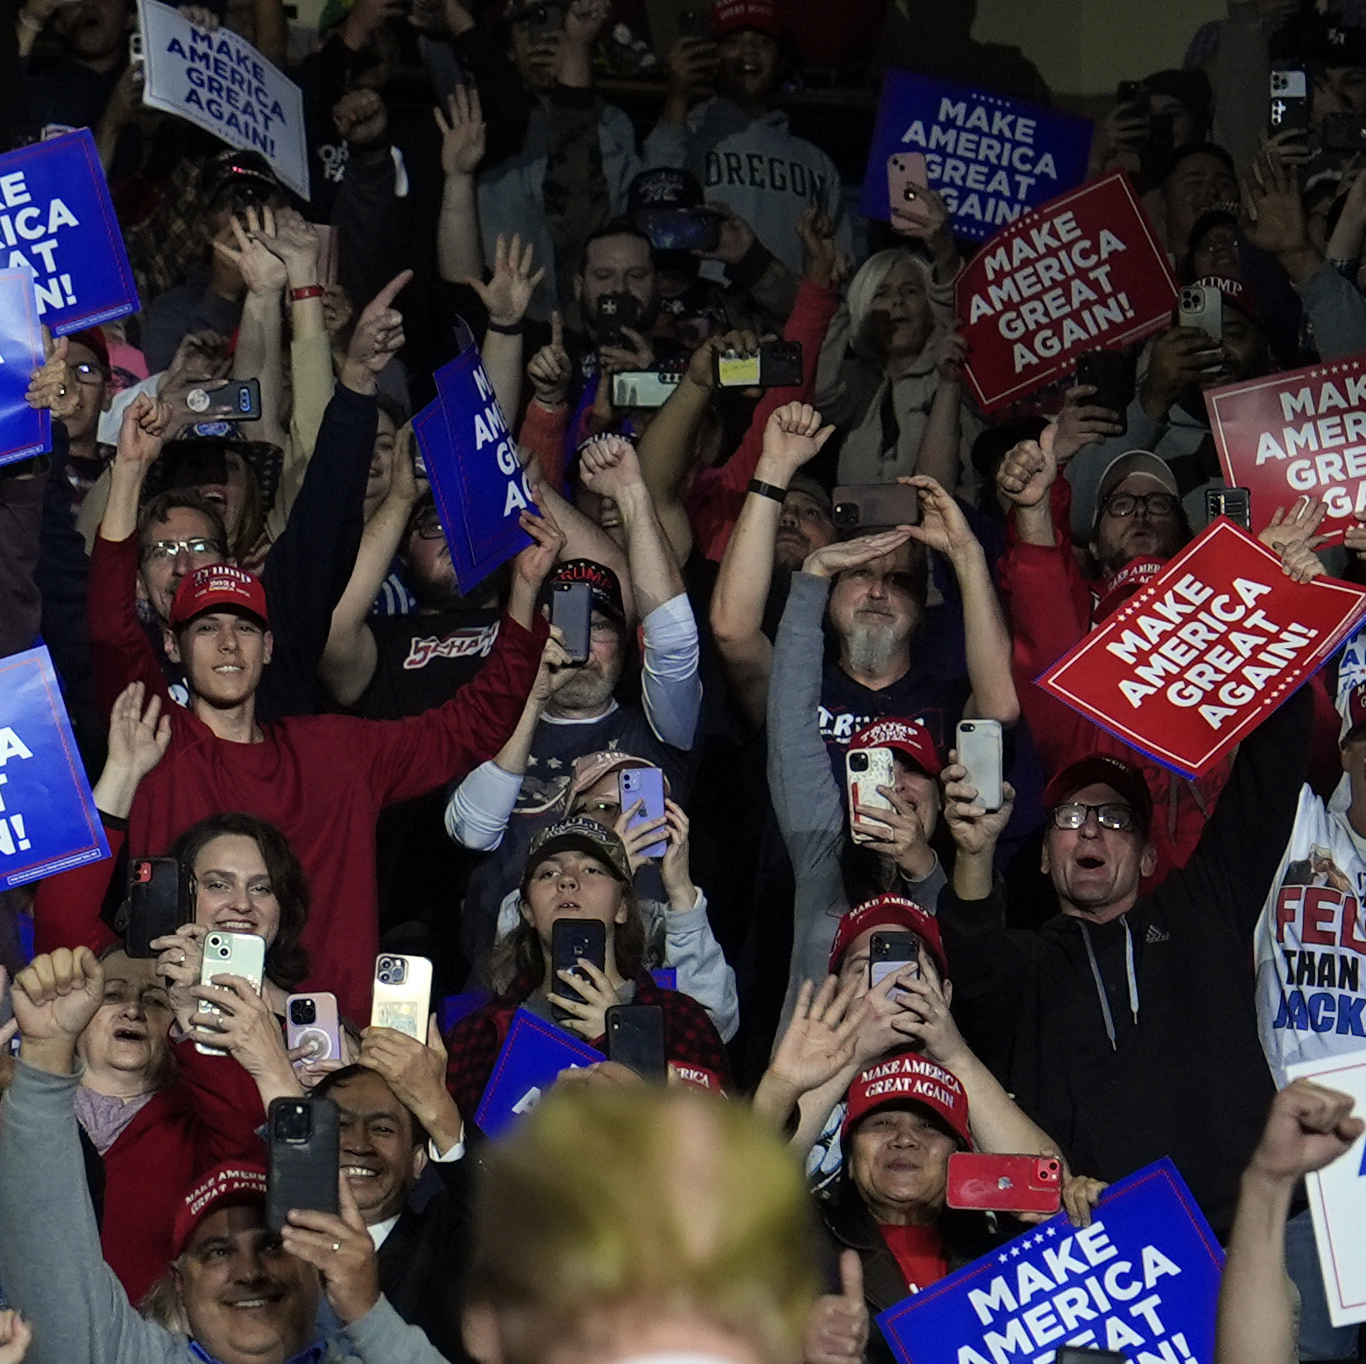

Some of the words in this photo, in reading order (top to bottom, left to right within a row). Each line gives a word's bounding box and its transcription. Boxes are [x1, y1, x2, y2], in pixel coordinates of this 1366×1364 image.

[167, 39, 285, 127] AMERICA
[192, 27, 264, 85] MAKE
[185, 88, 275, 159] AGAIN!
[187, 67, 273, 131] GREAT
[938, 97, 1037, 144] MAKE
[705, 151, 825, 200] OREGON
[902, 119, 1058, 181] AMERICA
[925, 155, 1036, 200] GREAT
[984, 210, 1082, 278] MAKE
[969, 228, 1126, 325] AMERICA
[999, 266, 1114, 340] GREAT
[1014, 293, 1136, 374] AGAIN!
[1133, 562, 1162, 580] AMER
[1106, 573, 1214, 665] MAKE
[1117, 577, 1271, 710] AMERICA
[1167, 609, 1280, 709] GREAT
[1197, 624, 1319, 730] AGAIN!
[849, 901, 881, 919] MAKE
[883, 897, 931, 919] AMERICA
[1283, 950, 1361, 990] THAN
[678, 1066, 712, 1090] RICA
[861, 1060, 899, 1086] MAKE
[901, 1058, 961, 1096] AMERICA
[865, 1078, 911, 1098] GREAT
[913, 1082, 955, 1109] AGAIN
[968, 1221, 1119, 1327] MAKE
